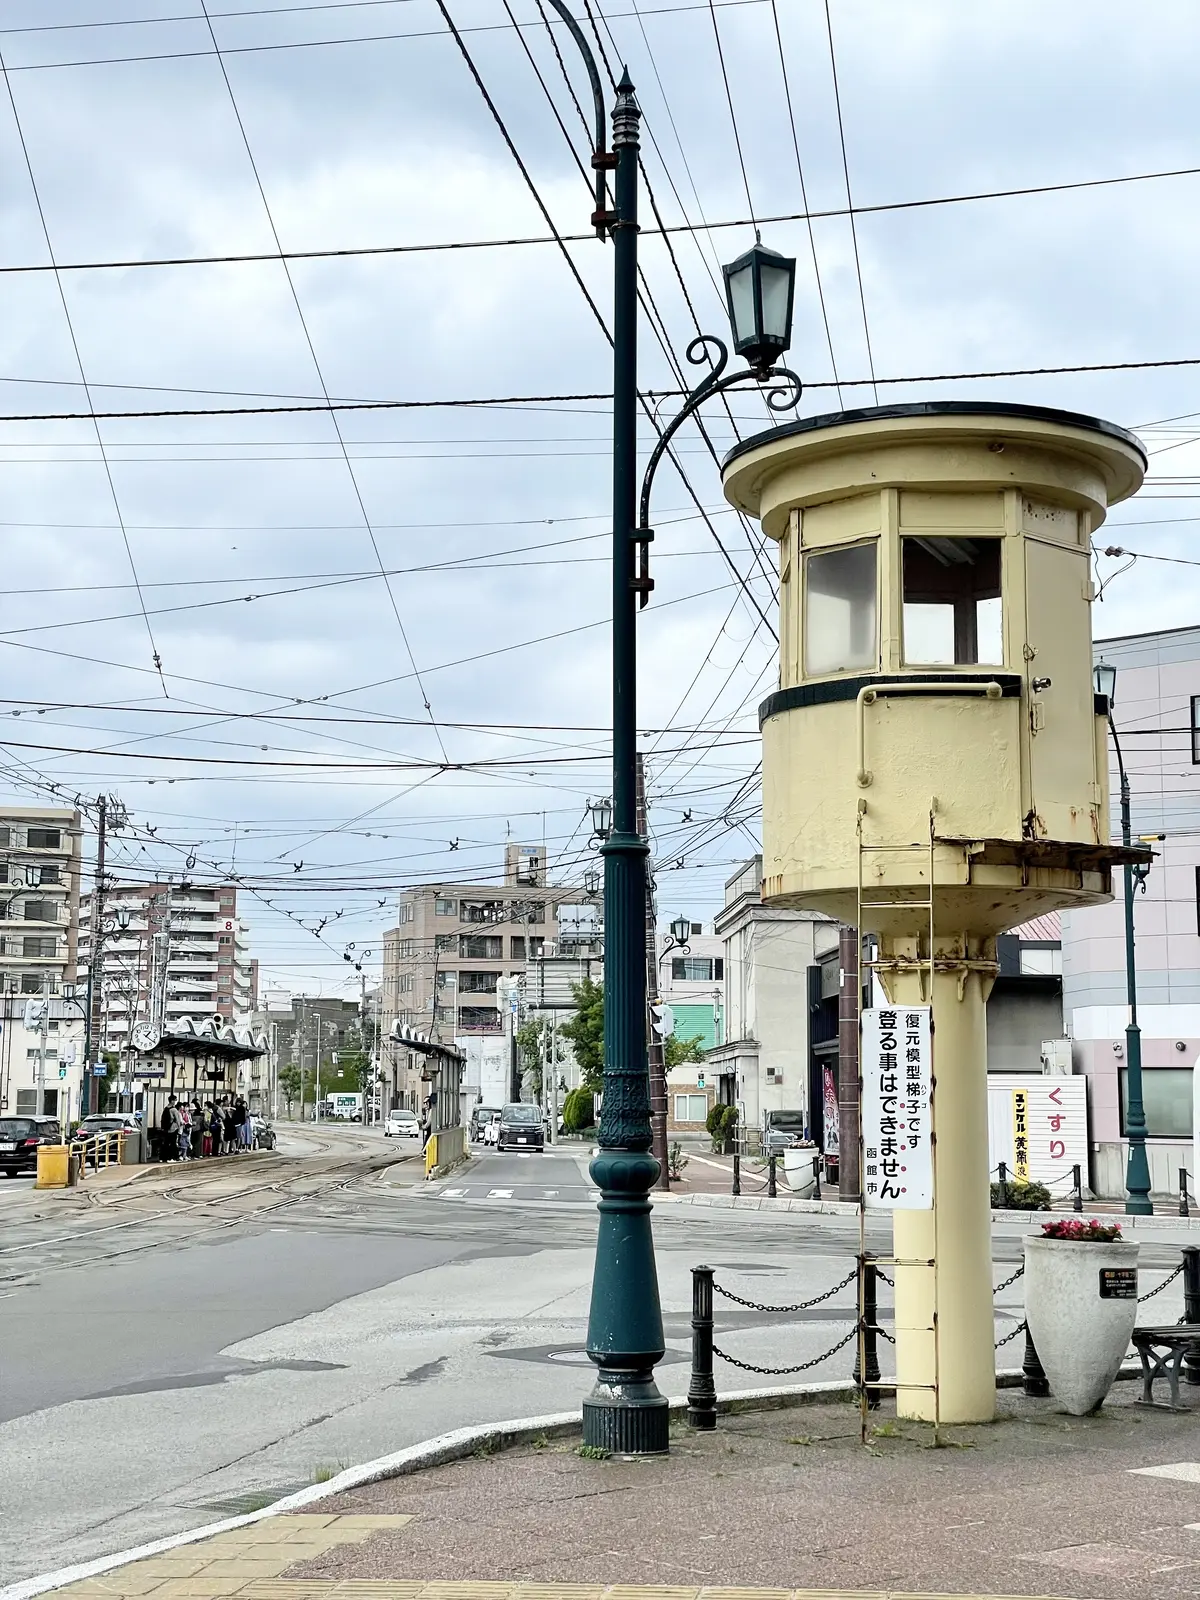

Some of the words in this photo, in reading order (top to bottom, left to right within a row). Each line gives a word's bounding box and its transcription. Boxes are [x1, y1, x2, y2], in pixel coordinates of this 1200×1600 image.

[225, 921, 232, 931] 8
[878, 1010, 900, 1199] 登る事はできません
[905, 1013, 921, 1149] 復元模型梯子です
[1047, 1087, 1066, 1159] くすり
[866, 1147, 878, 1195] 函館市
